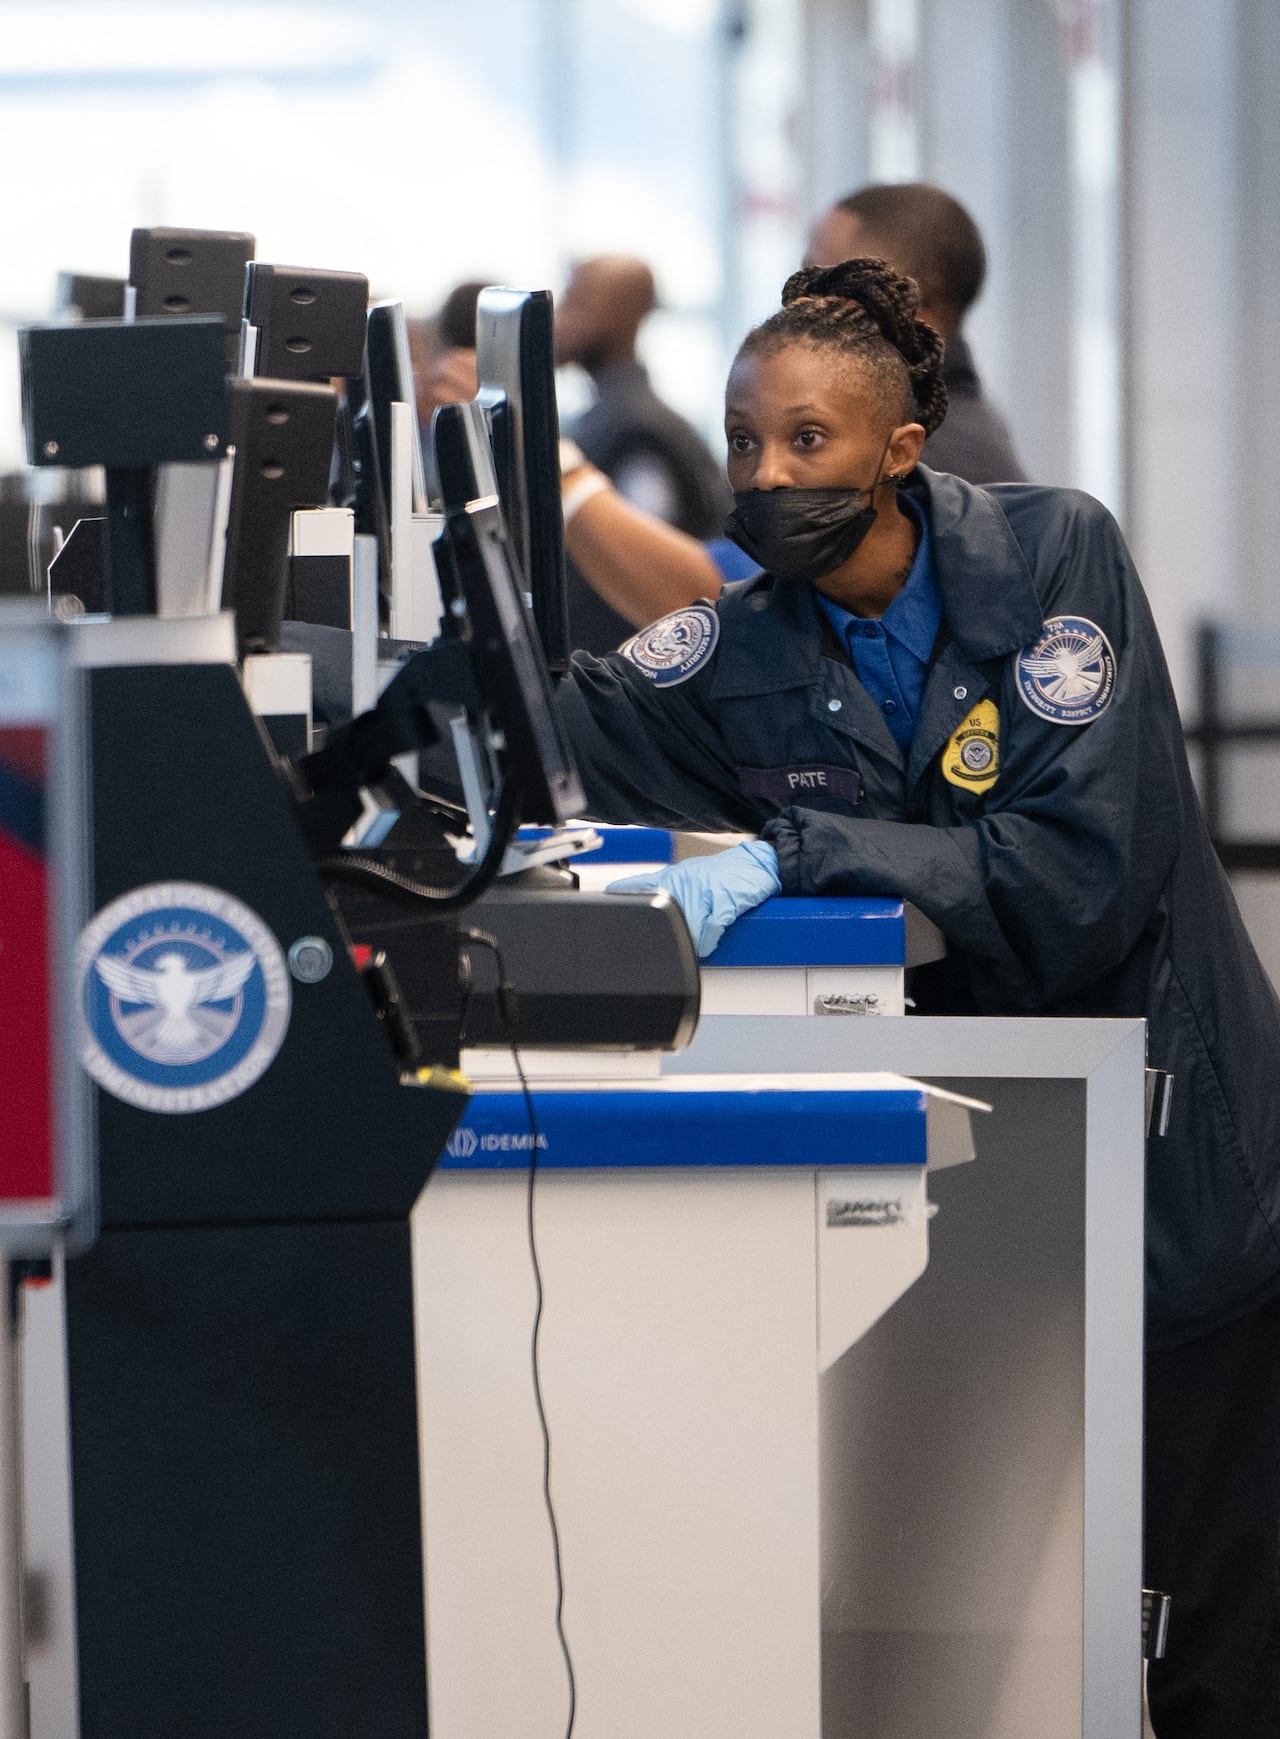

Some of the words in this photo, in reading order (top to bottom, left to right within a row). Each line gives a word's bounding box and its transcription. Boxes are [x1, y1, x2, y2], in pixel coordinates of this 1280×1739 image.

[969, 718, 982, 727] US
[787, 771, 828, 789] PATE
[480, 1133, 549, 1152] IDEMIA
